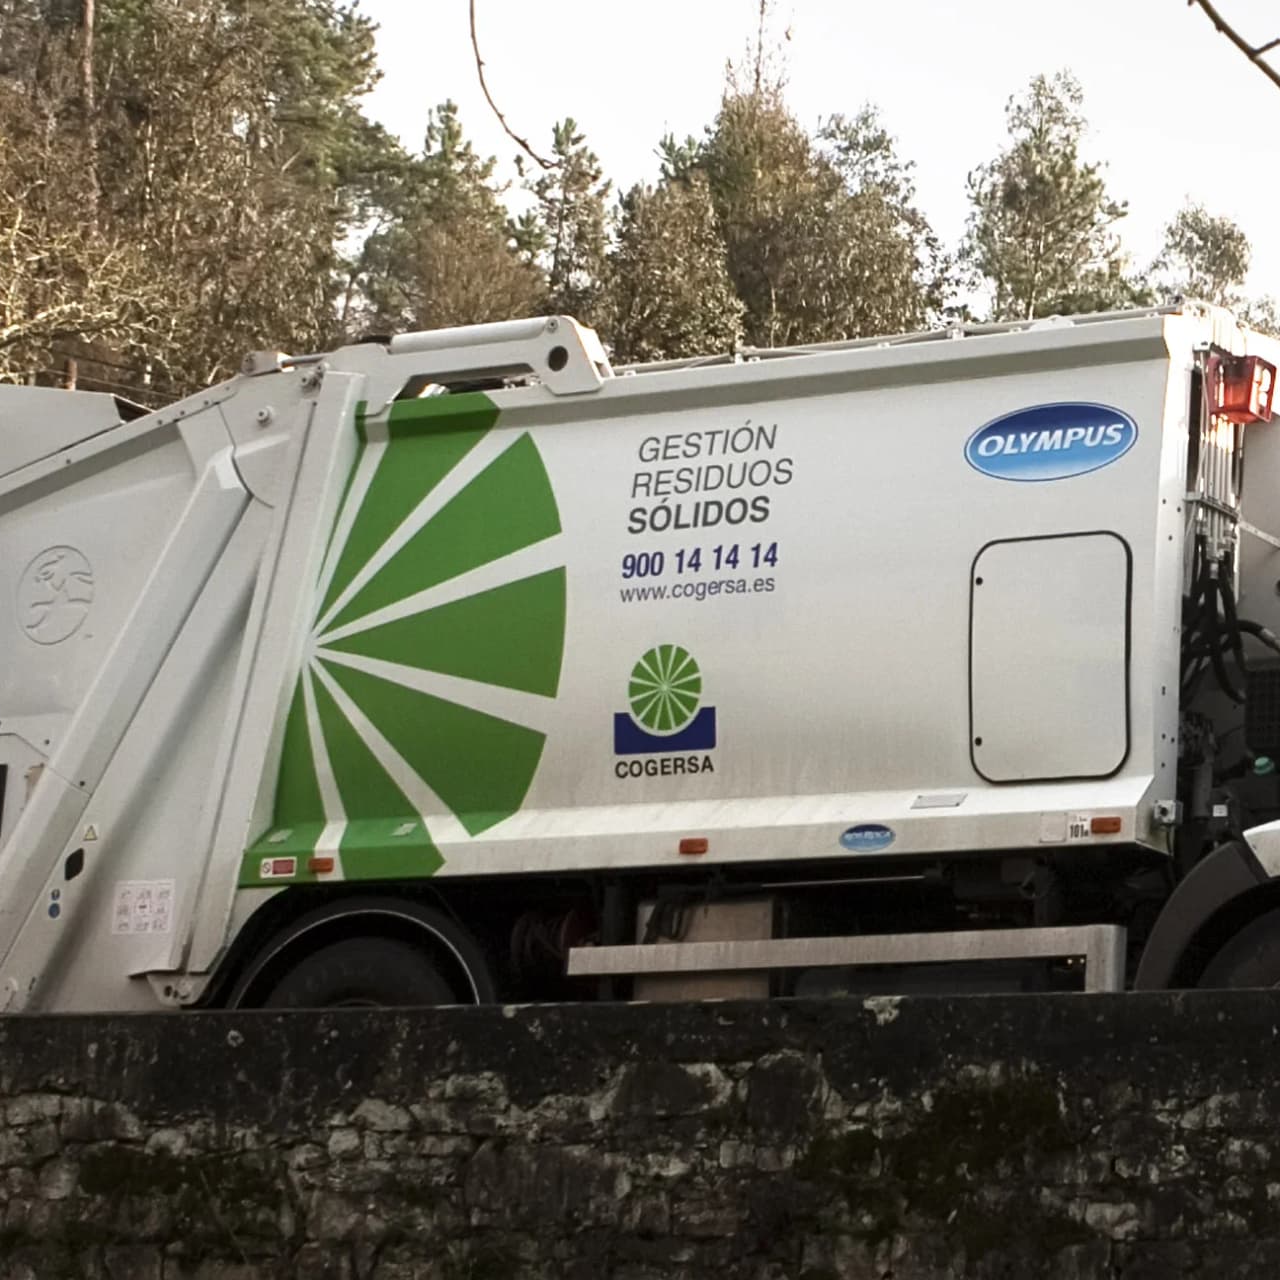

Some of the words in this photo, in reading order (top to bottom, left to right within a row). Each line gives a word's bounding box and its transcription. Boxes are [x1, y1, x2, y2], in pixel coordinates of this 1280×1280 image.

[639, 419, 778, 463] GESTIÓN
[977, 423, 1125, 458] OLYMPUS
[631, 458, 794, 499] RESIDUOS
[627, 495, 771, 535] SÓLIDOS
[621, 551, 665, 579] 900
[675, 547, 702, 574] 14
[713, 544, 740, 570] 14
[751, 542, 778, 568] 14
[620, 577, 775, 602] www.cogersa.es
[615, 755, 714, 779] COGERSA
